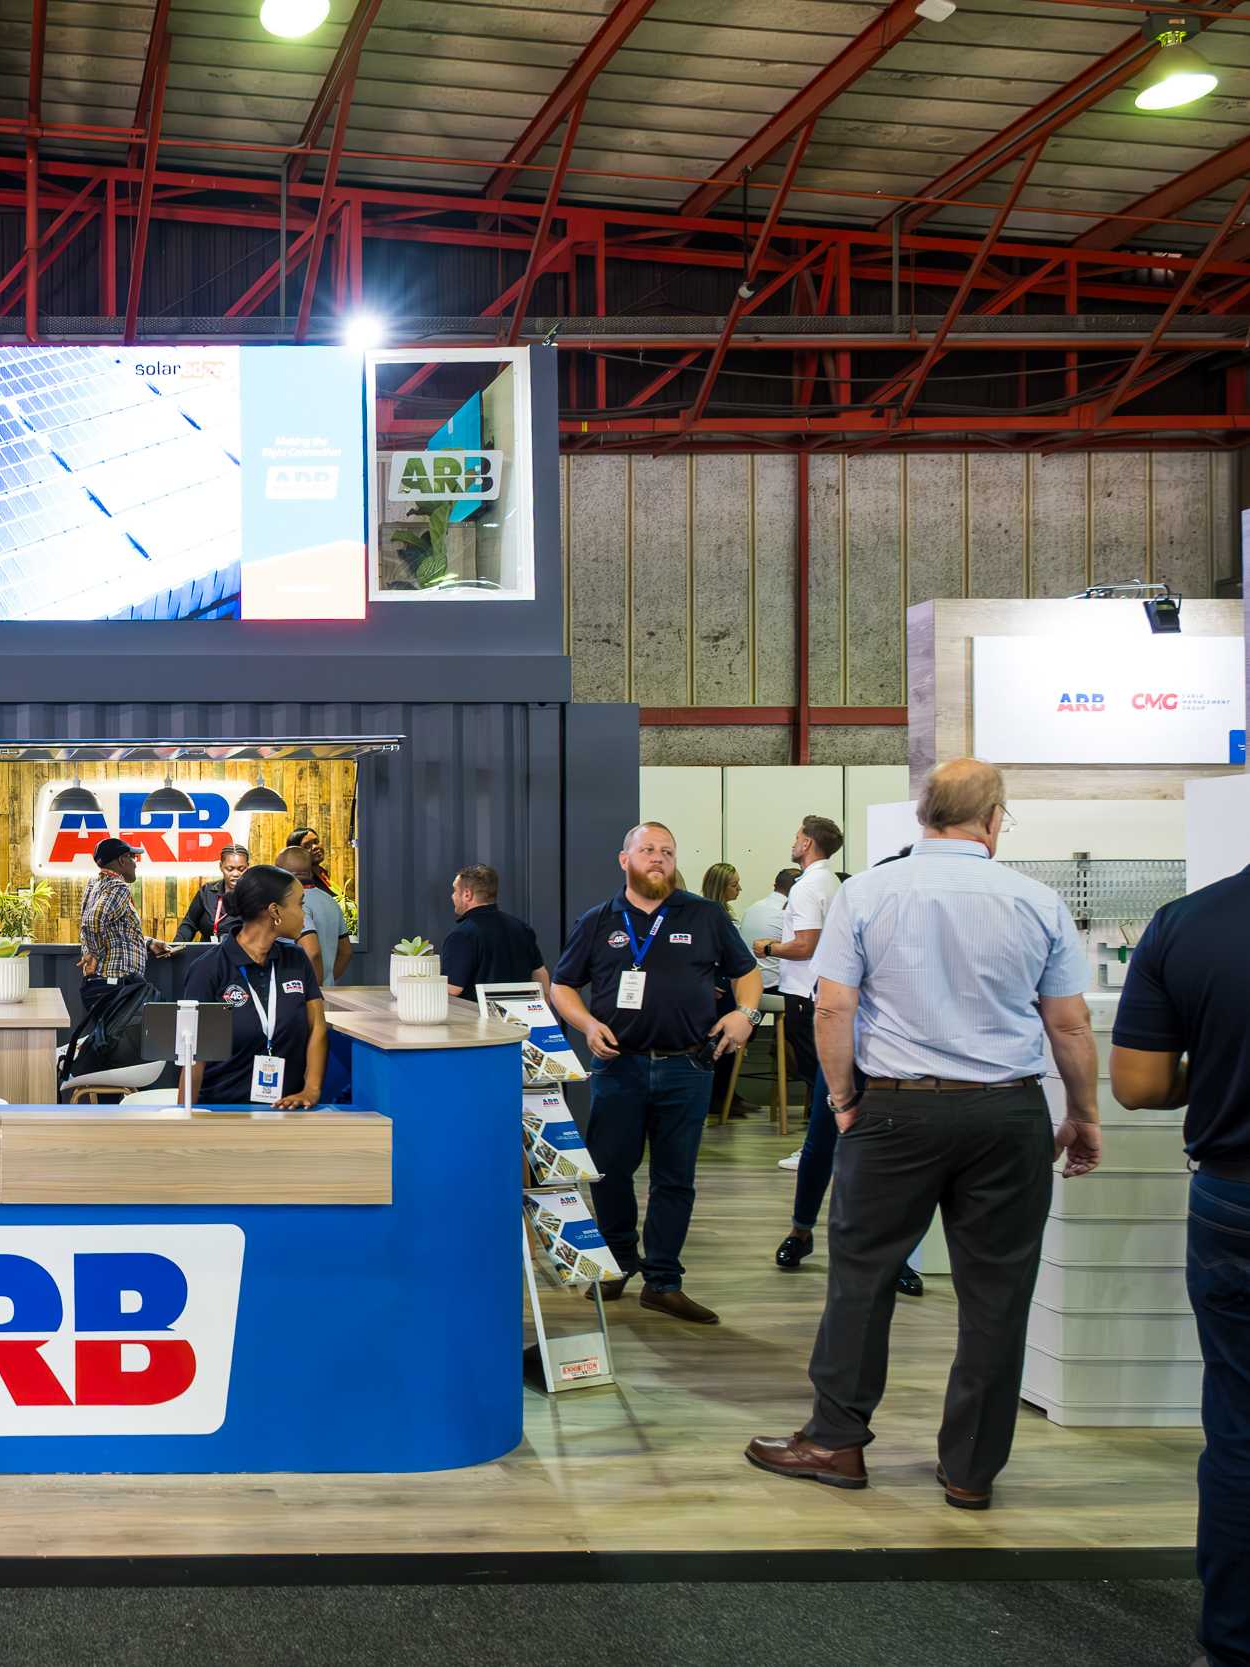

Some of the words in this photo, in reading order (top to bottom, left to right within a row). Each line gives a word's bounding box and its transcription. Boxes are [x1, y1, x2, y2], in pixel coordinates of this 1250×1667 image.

[275, 436, 311, 448] Making
[312, 436, 328, 446] the
[261, 447, 287, 459] Right
[288, 447, 342, 457] Connection
[397, 456, 494, 494] ARB
[271, 471, 332, 494] ARB
[1057, 693, 1106, 712] ARB
[1131, 693, 1179, 711] CMG
[48, 792, 234, 863] ARB
[286, 981, 302, 990] ARB
[230, 991, 243, 1000] 45
[527, 1004, 544, 1012] ARB
[543, 1098, 560, 1106] ARB
[560, 1196, 578, 1205] ARB
[563, 1363, 598, 1373] EXHIBITION
